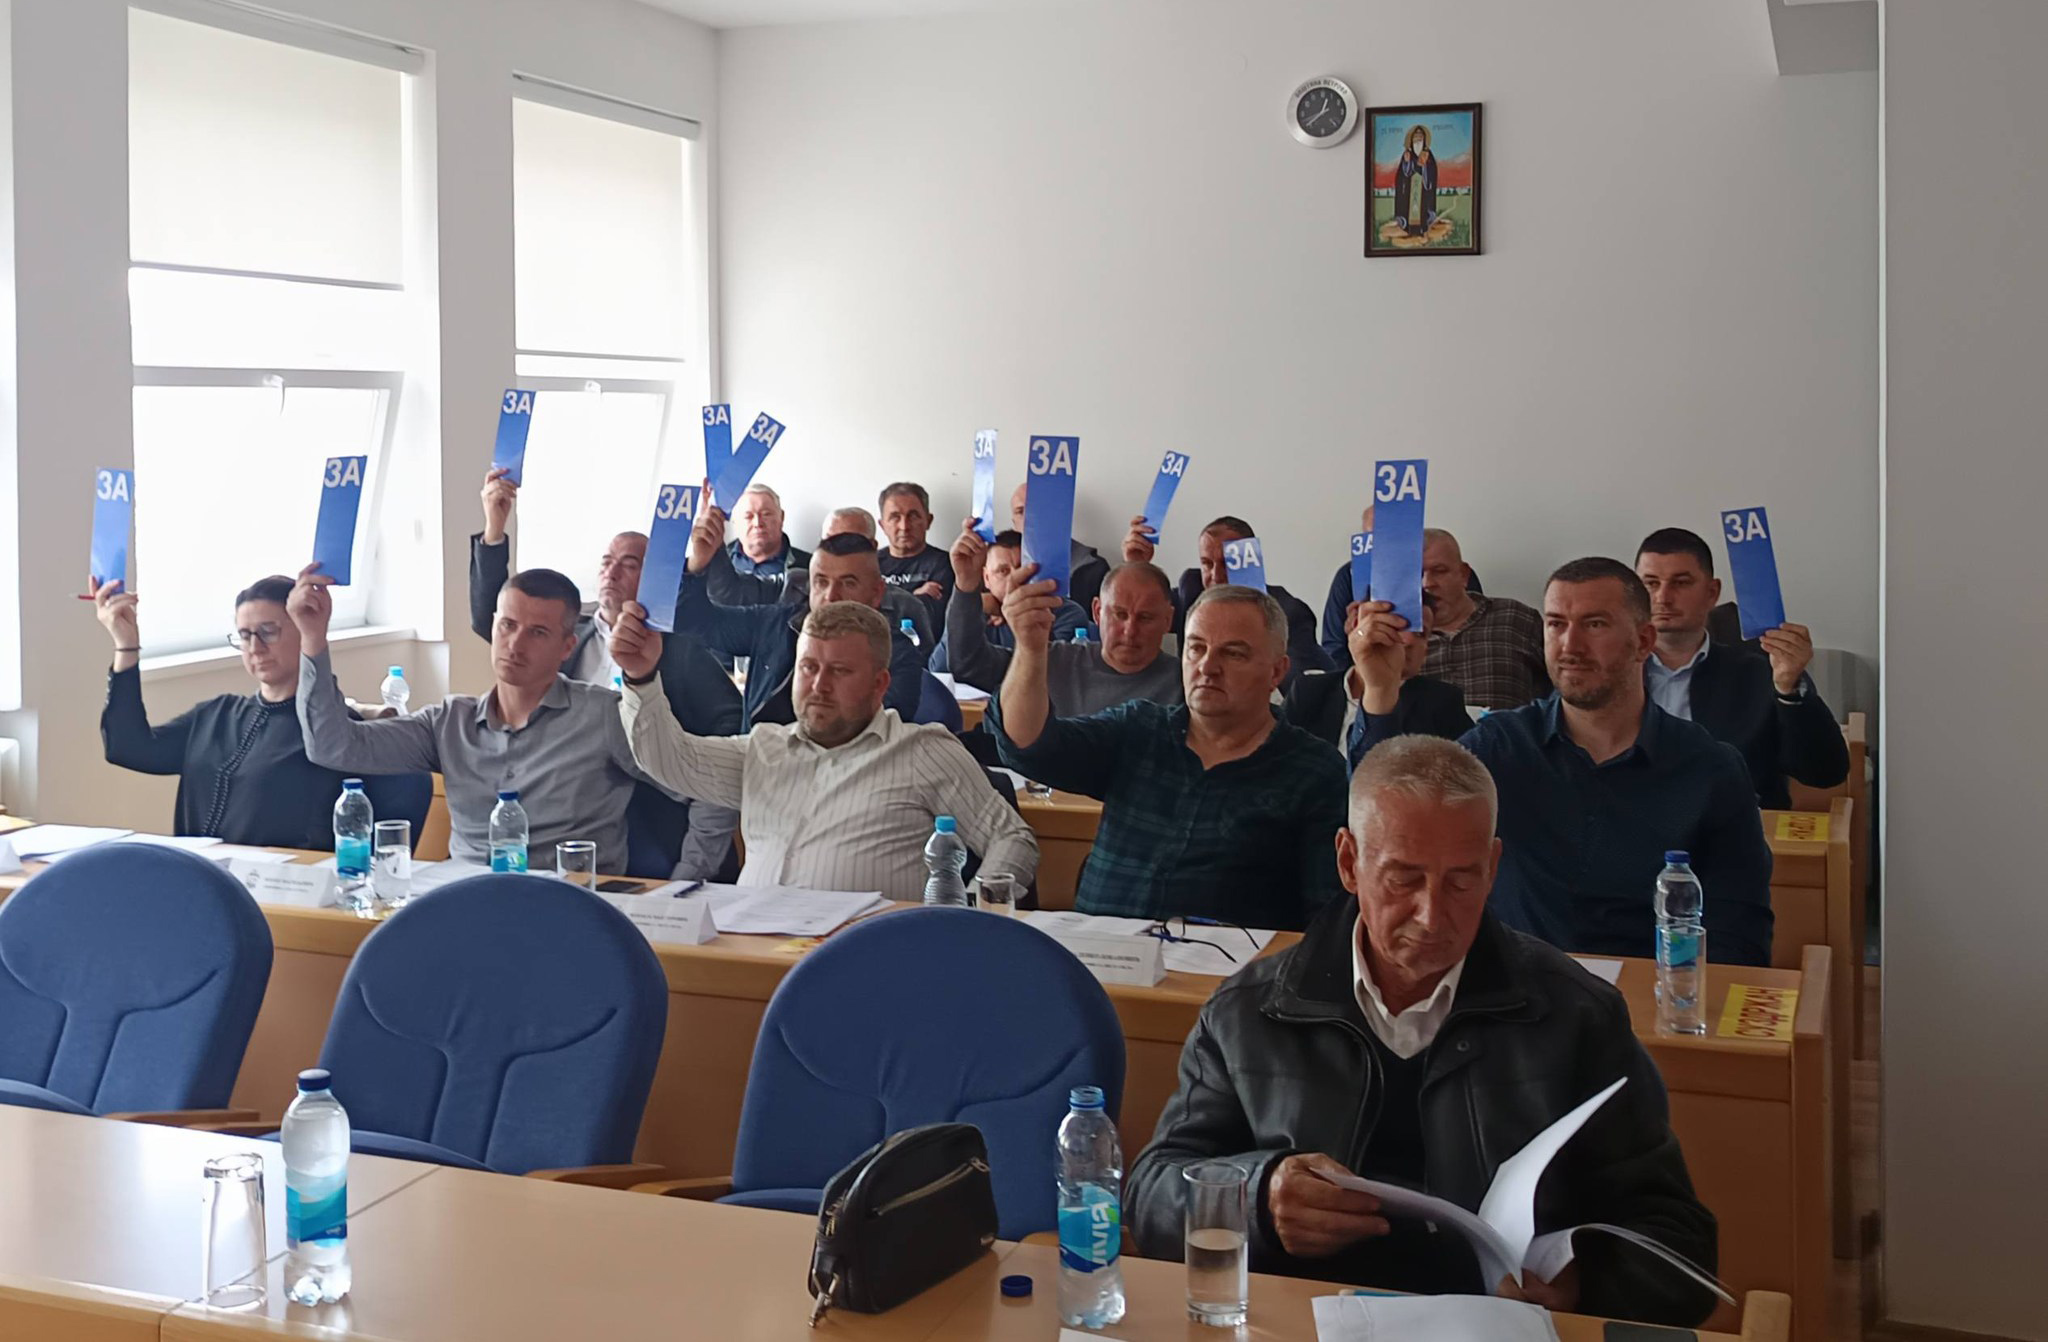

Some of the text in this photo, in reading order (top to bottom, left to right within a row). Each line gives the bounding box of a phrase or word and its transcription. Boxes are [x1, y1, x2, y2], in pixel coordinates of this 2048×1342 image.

[502, 391, 531, 415] ЗА
[703, 405, 729, 426] ЗА
[750, 415, 778, 448] ЗА
[975, 432, 993, 457] ЗА
[1029, 439, 1073, 475] ЗА
[1161, 452, 1184, 477] ЗА
[97, 470, 129, 502] ЗА
[324, 458, 360, 488] ЗА
[1376, 464, 1421, 502] ЗА
[656, 486, 692, 520] ЗА
[1725, 512, 1767, 543] ЗА
[1226, 542, 1260, 570] ЗА
